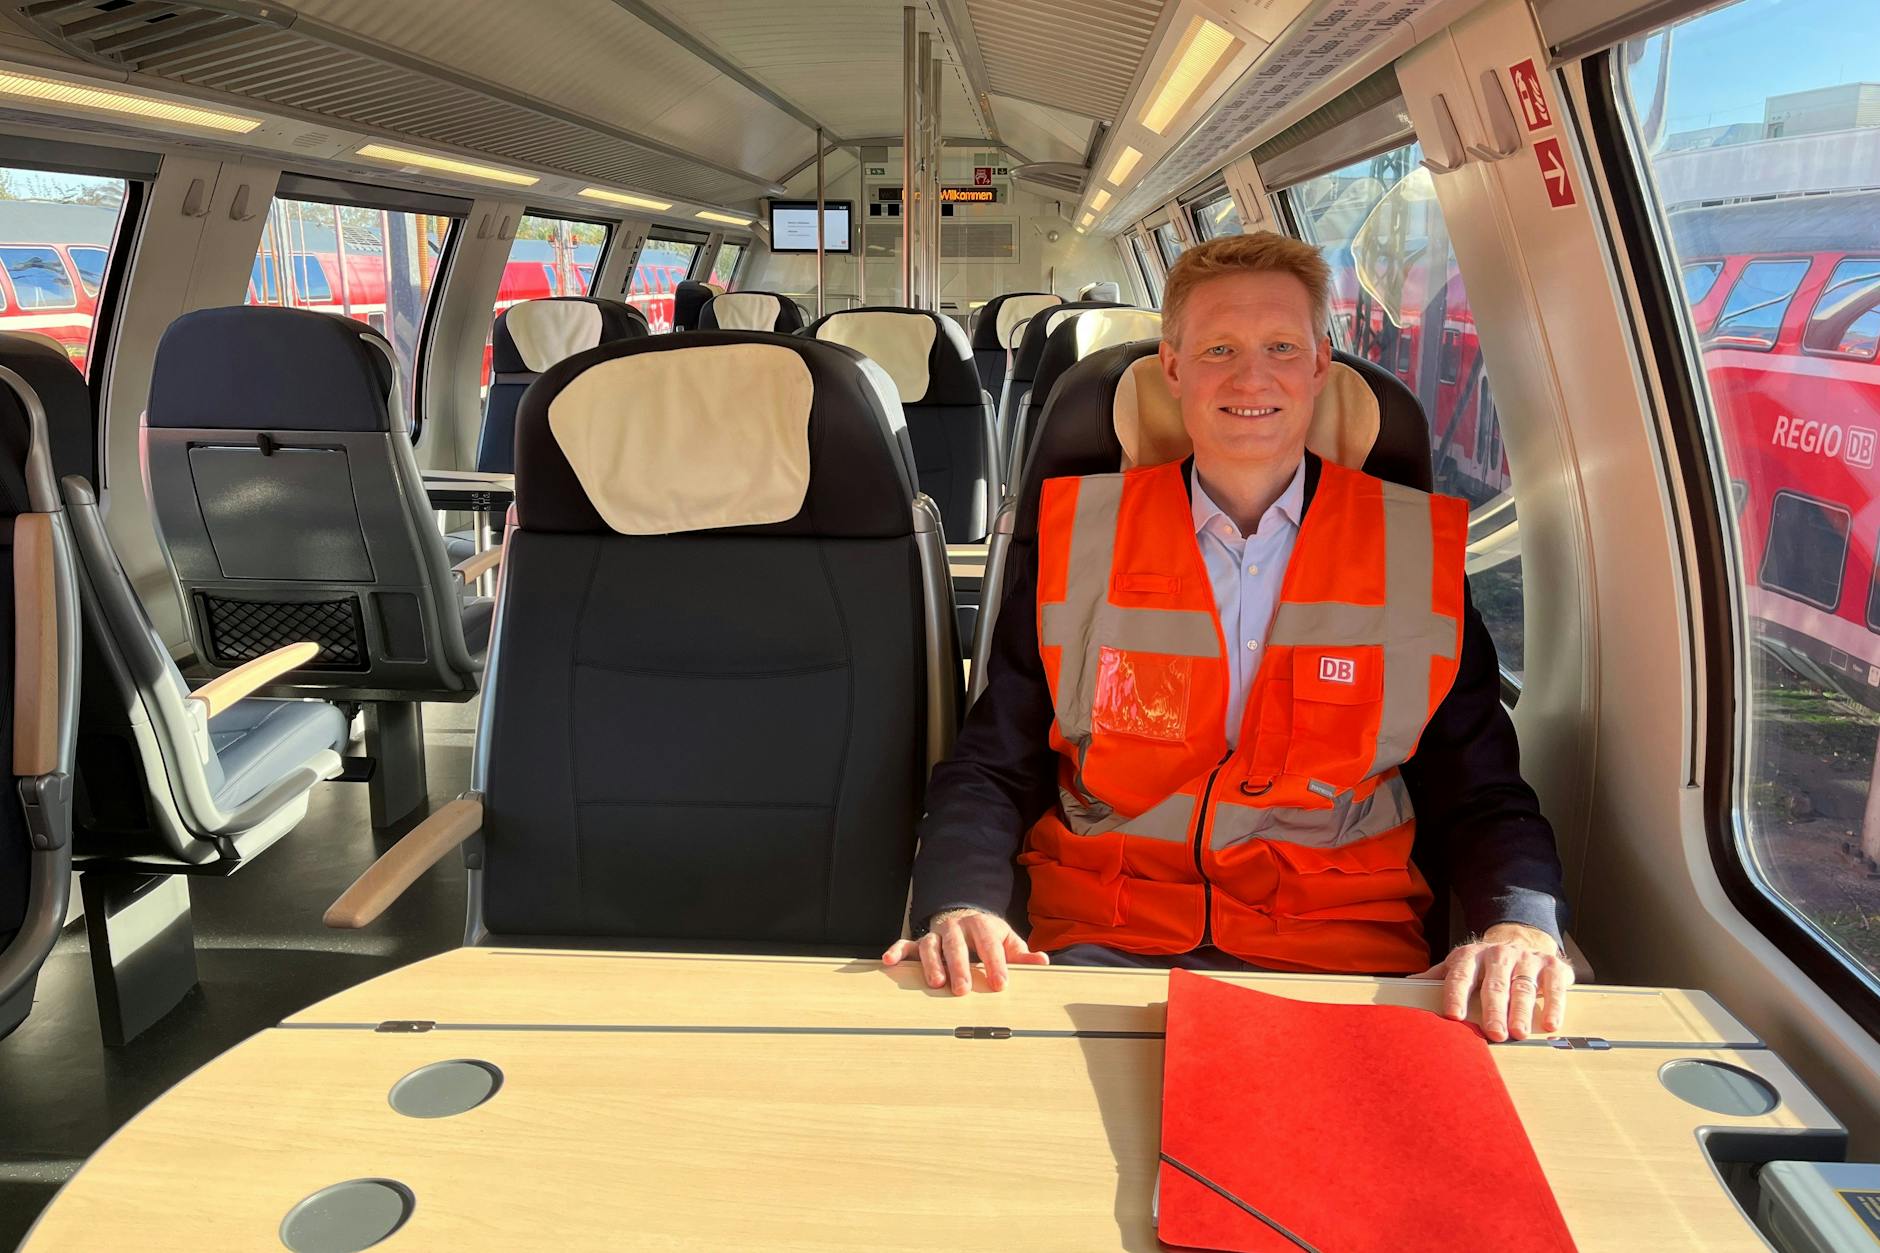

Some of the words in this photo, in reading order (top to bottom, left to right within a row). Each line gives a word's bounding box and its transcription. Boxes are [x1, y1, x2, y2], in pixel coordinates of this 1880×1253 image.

[1771, 415, 1843, 458] REGIO
[1848, 431, 1873, 462] DB
[1321, 658, 1352, 682] DB
